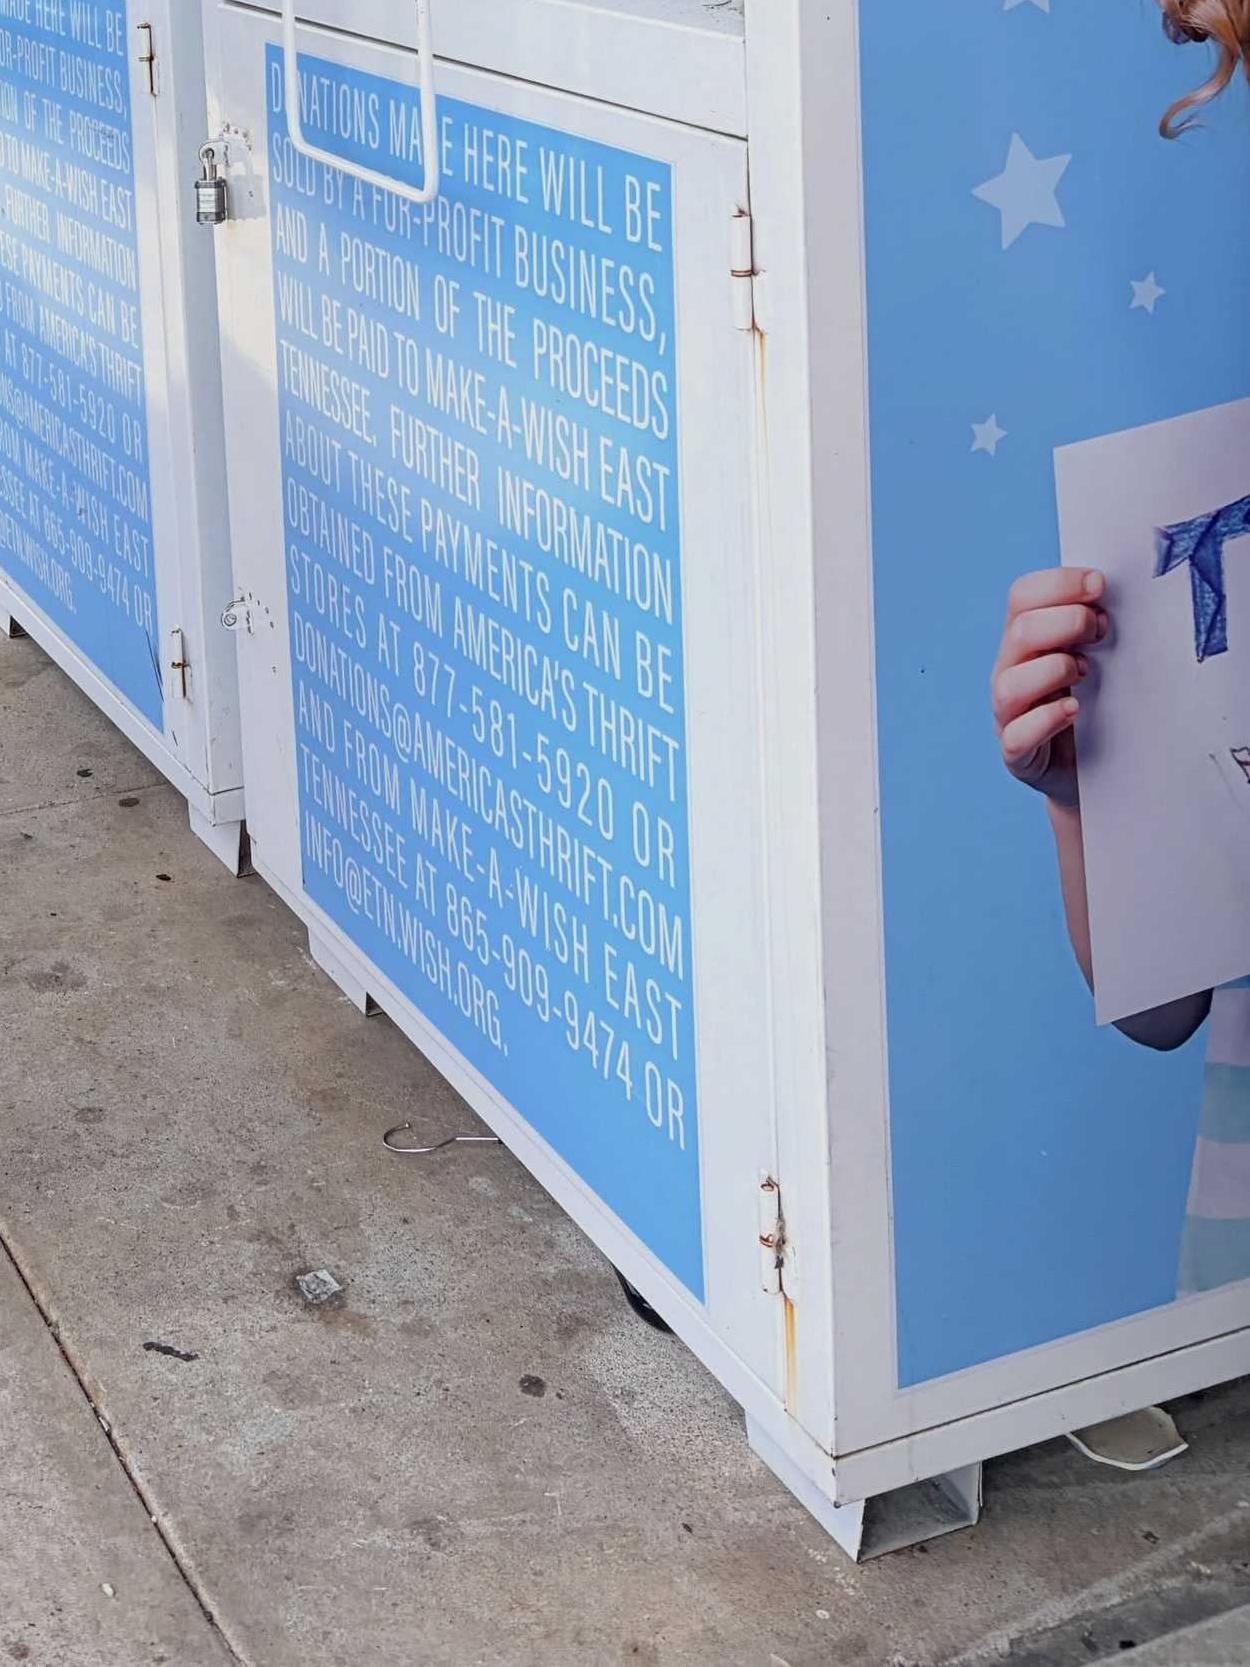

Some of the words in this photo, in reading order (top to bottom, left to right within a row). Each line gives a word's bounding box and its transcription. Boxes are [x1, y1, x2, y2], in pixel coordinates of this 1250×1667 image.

[59, 50, 127, 125] BUSINESS,
[105, 9, 123, 58] BE
[5, 130, 19, 176] TO
[20, 137, 98, 219] MAKE-A-WISH
[101, 177, 133, 238] EAST
[23, 89, 37, 134] OF
[42, 98, 63, 147] THE
[69, 110, 130, 179] PROCEEDS
[270, 62, 380, 150] DNATIONS
[388, 99, 453, 177] MAE
[463, 122, 528, 204] HERE
[538, 146, 612, 234] WILL
[625, 173, 661, 251] BE
[4, 180, 50, 244] FURTHER
[56, 209, 136, 296] INFORMATION
[21, 238, 84, 319] PAYMENTS
[87, 279, 116, 340] CAN
[120, 300, 138, 355] BE
[272, 132, 316, 199] SOLD
[323, 164, 346, 213] BY
[351, 175, 365, 221] A
[372, 170, 506, 281] FOR-PROFIT
[514, 223, 665, 356] BUSINESS,
[275, 203, 308, 268] AND
[317, 221, 329, 278] A
[340, 232, 420, 322] PORTION
[434, 273, 460, 342] OF
[474, 291, 516, 369] THE
[533, 317, 668, 442] PROCEEDS
[3, 324, 17, 373] AT
[21, 337, 115, 449] 877-581-5920
[122, 411, 143, 471] OR
[5, 277, 35, 336] FROM
[38, 299, 97, 381] AMERICA'S
[99, 341, 143, 414] THRIFT
[277, 272, 318, 343] WILL
[321, 294, 343, 357] BE
[347, 307, 389, 382] PAID
[394, 330, 419, 398] TO
[425, 346, 589, 491] MAKE-A-WISH
[599, 434, 671, 536] EAST
[23, 434, 108, 547] MAKE-A-WISH
[113, 510, 150, 585] EAST
[27, 486, 41, 534] AT
[42, 499, 129, 619] 865-909-9474
[133, 582, 153, 641] OR
[284, 410, 342, 497] ABOUT
[348, 450, 412, 543] THESE
[421, 495, 551, 637] PAYMENTS
[562, 583, 620, 683] CAN
[636, 630, 673, 719] BE
[390, 402, 480, 511] FURTHER
[498, 463, 672, 628] INFORMATION
[287, 477, 375, 590] OBTAINED
[383, 543, 442, 639] FROM
[451, 590, 576, 736] AMERICA'S
[584, 680, 679, 812] THRIFT
[290, 544, 366, 652] STORES
[376, 608, 402, 681] AT
[412, 635, 614, 848] 877-581-5920
[632, 798, 674, 895] OR
[294, 611, 683, 986] DONATIONS@AMERICASTHRIFT.COM
[297, 677, 335, 758] AND
[344, 717, 400, 816] FROM
[410, 774, 589, 987] MAKE-A-WISH
[604, 941, 683, 1071] EAST
[301, 742, 408, 891] TENNESSEE
[413, 845, 438, 920] AT
[445, 874, 633, 1106] 865-909-9474
[645, 1057, 685, 1156] OR
